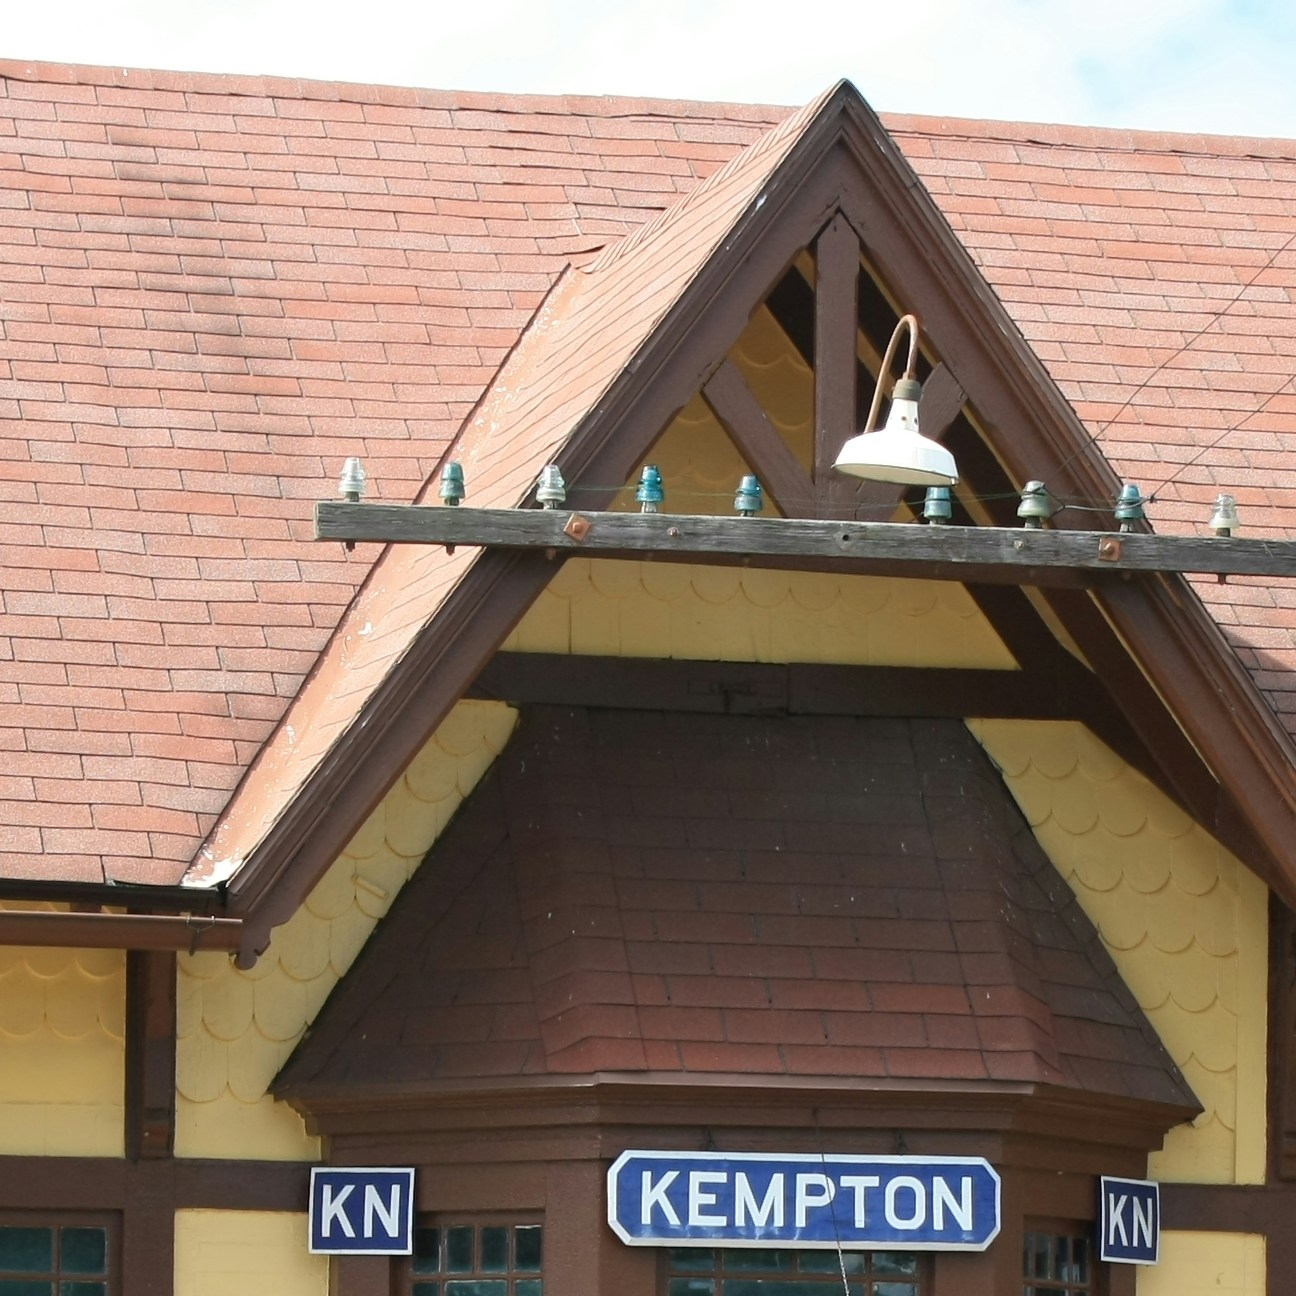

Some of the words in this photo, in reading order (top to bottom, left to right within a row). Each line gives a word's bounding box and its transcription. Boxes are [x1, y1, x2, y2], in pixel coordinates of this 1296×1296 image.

[320, 1183, 401, 1239] KN
[640, 1169, 975, 1232] KEMPTON
[1108, 1194, 1155, 1249] KN
